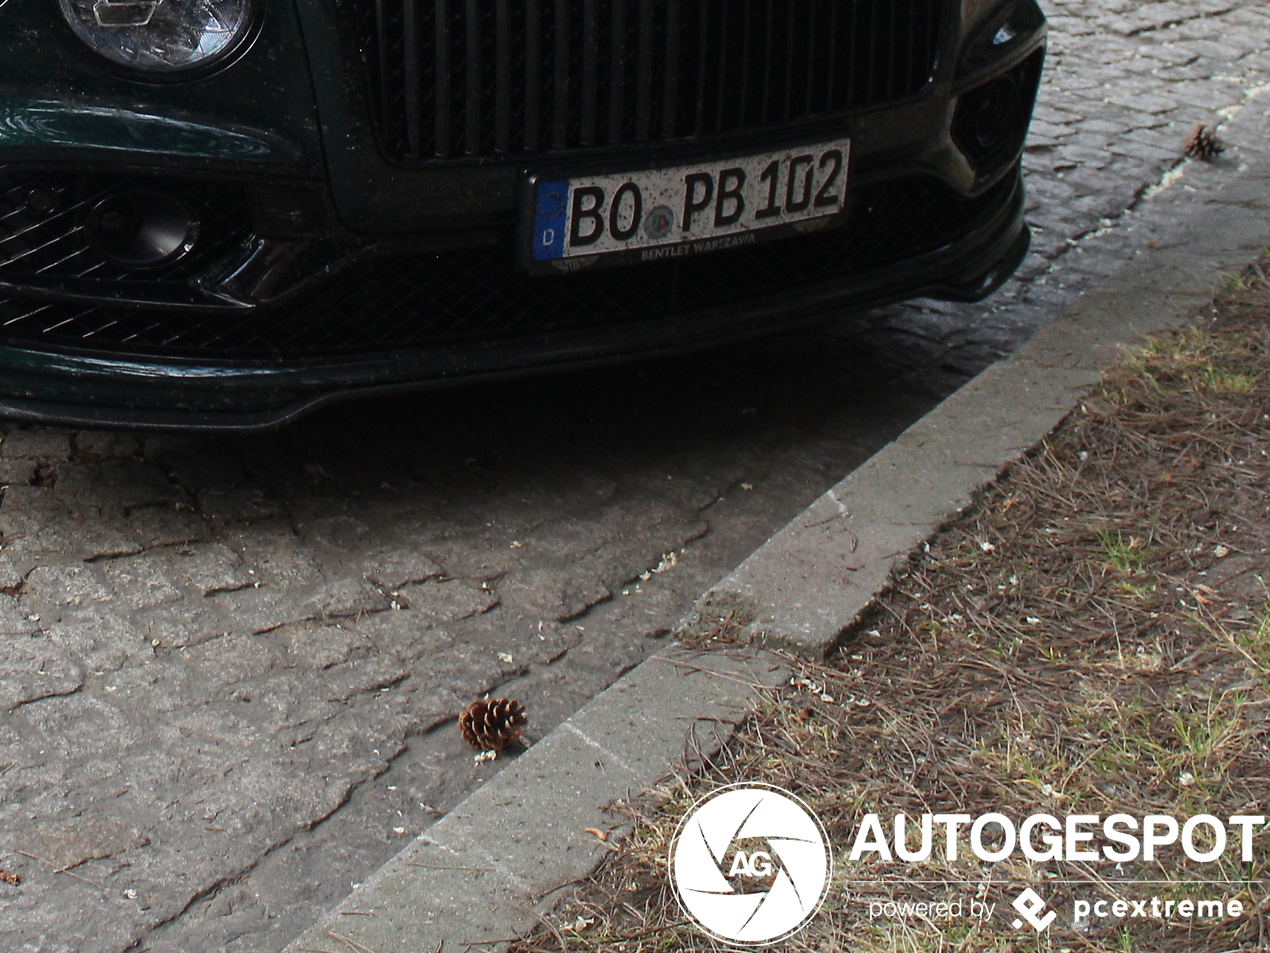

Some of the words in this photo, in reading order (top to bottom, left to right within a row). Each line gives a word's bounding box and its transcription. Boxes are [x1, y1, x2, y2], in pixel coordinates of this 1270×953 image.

[569, 182, 643, 248] BO
[681, 166, 746, 232] PB
[754, 149, 843, 220] 102
[542, 229, 554, 246] D
[641, 244, 690, 261] BENTLEY
[693, 233, 756, 254] WARSZAWA
